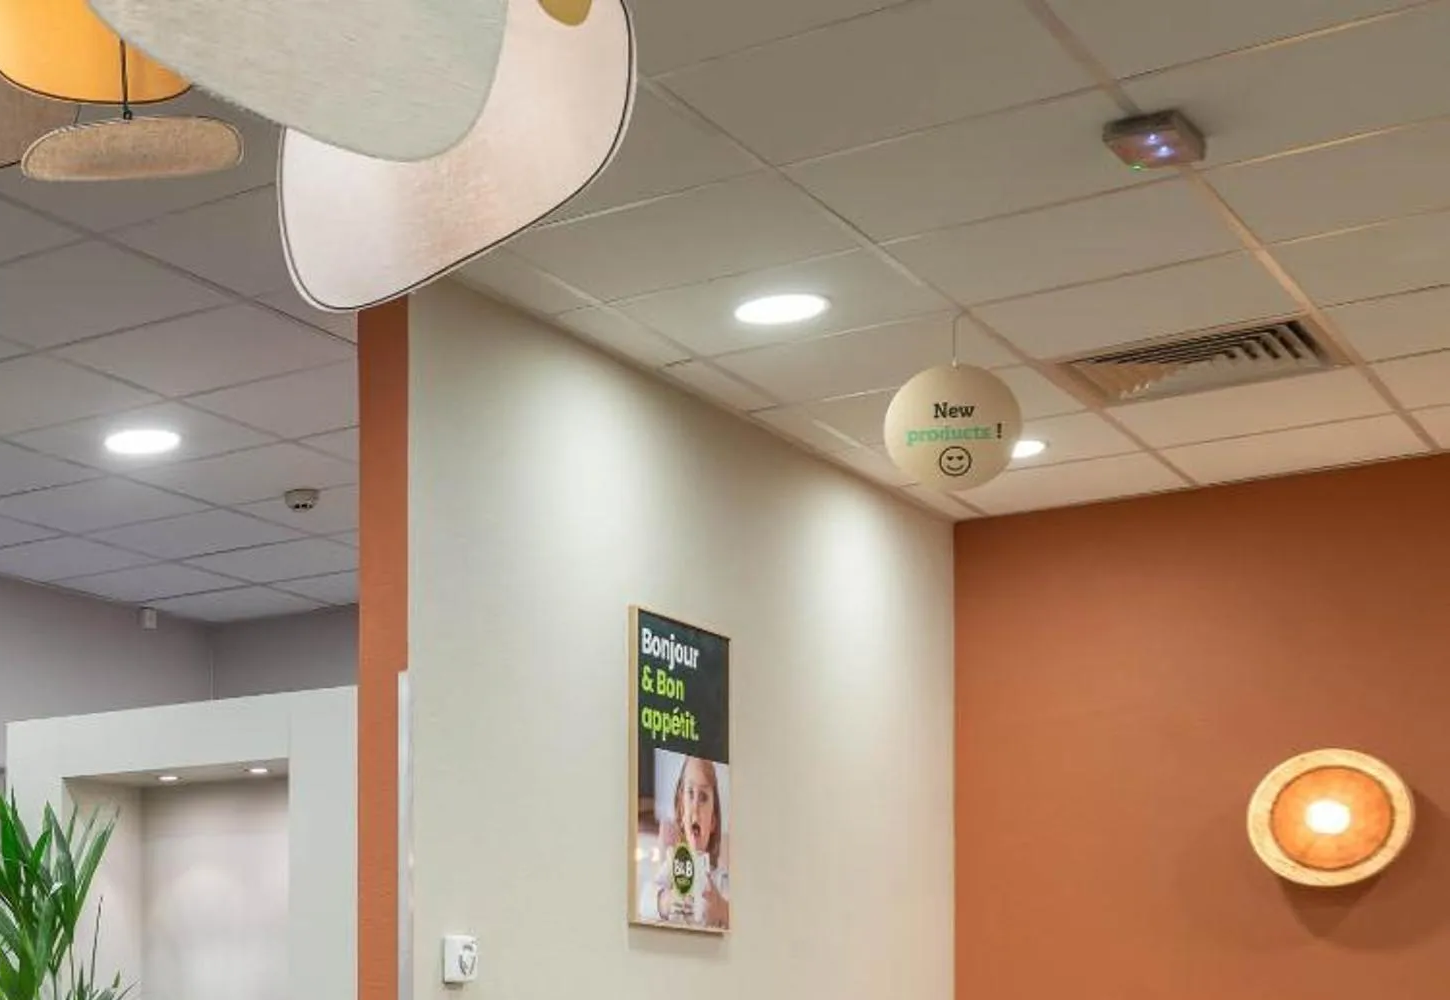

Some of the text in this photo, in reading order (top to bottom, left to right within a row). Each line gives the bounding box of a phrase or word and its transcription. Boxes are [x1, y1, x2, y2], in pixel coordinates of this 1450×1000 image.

[933, 401, 975, 419] New
[905, 423, 1003, 448] products !
[642, 627, 700, 671] Bonjour
[641, 664, 685, 701] & Bon
[641, 706, 699, 741] appétit.
